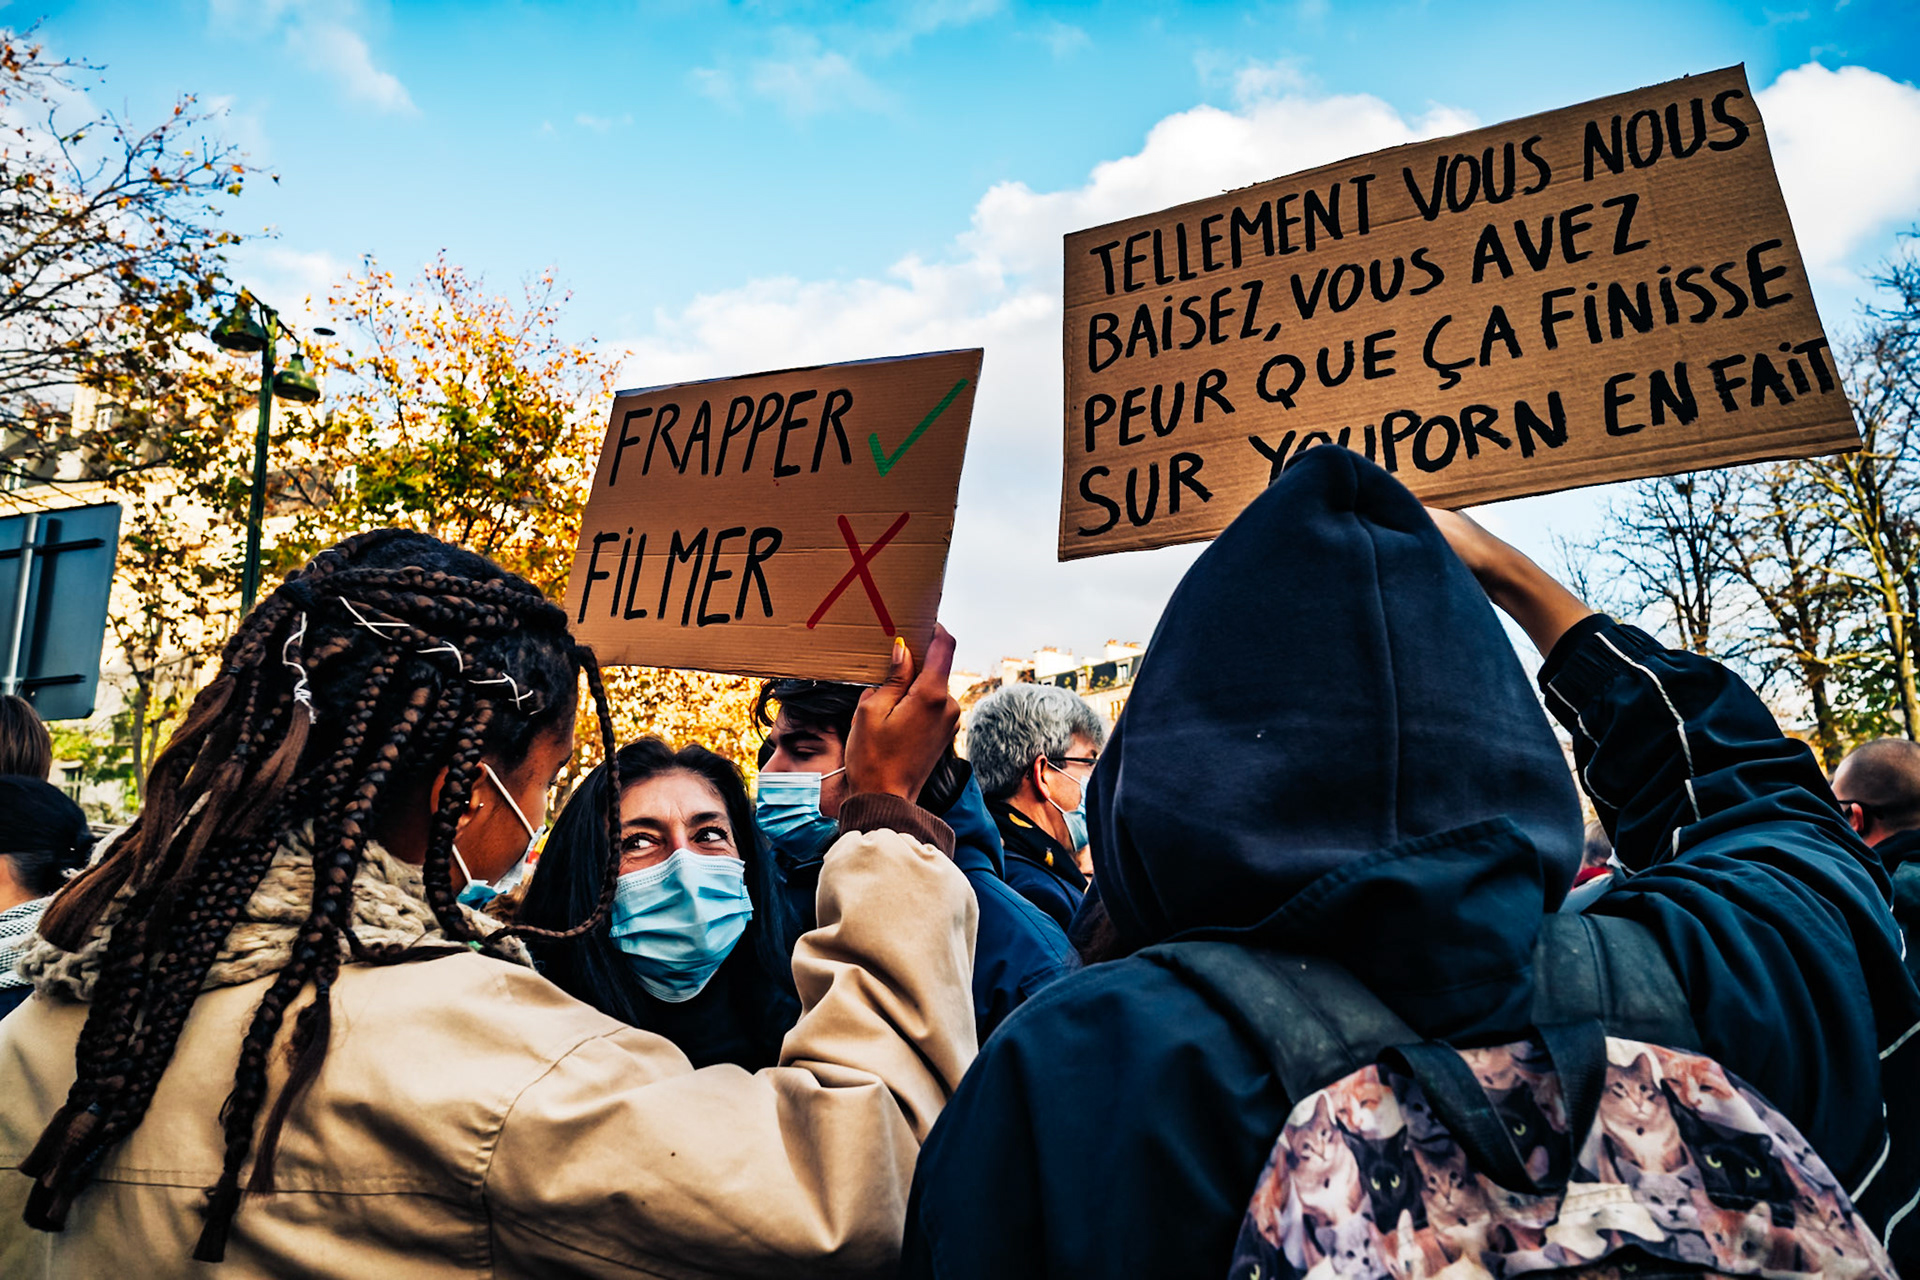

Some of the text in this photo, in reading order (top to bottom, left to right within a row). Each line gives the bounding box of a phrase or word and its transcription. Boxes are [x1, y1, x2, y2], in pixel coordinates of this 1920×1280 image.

[1089, 88, 1751, 296] TELLEMENT VOUS NOUS
[1290, 247, 1445, 321] VOUS
[1472, 193, 1652, 284] AVEZ
[608, 388, 854, 488] FRAPPER
[1078, 451, 1214, 537] SUR
[1603, 360, 1700, 437] EN
[1084, 368, 1236, 453] PEUR
[1256, 328, 1398, 411] QUE
[1422, 304, 1524, 391] ÇA
